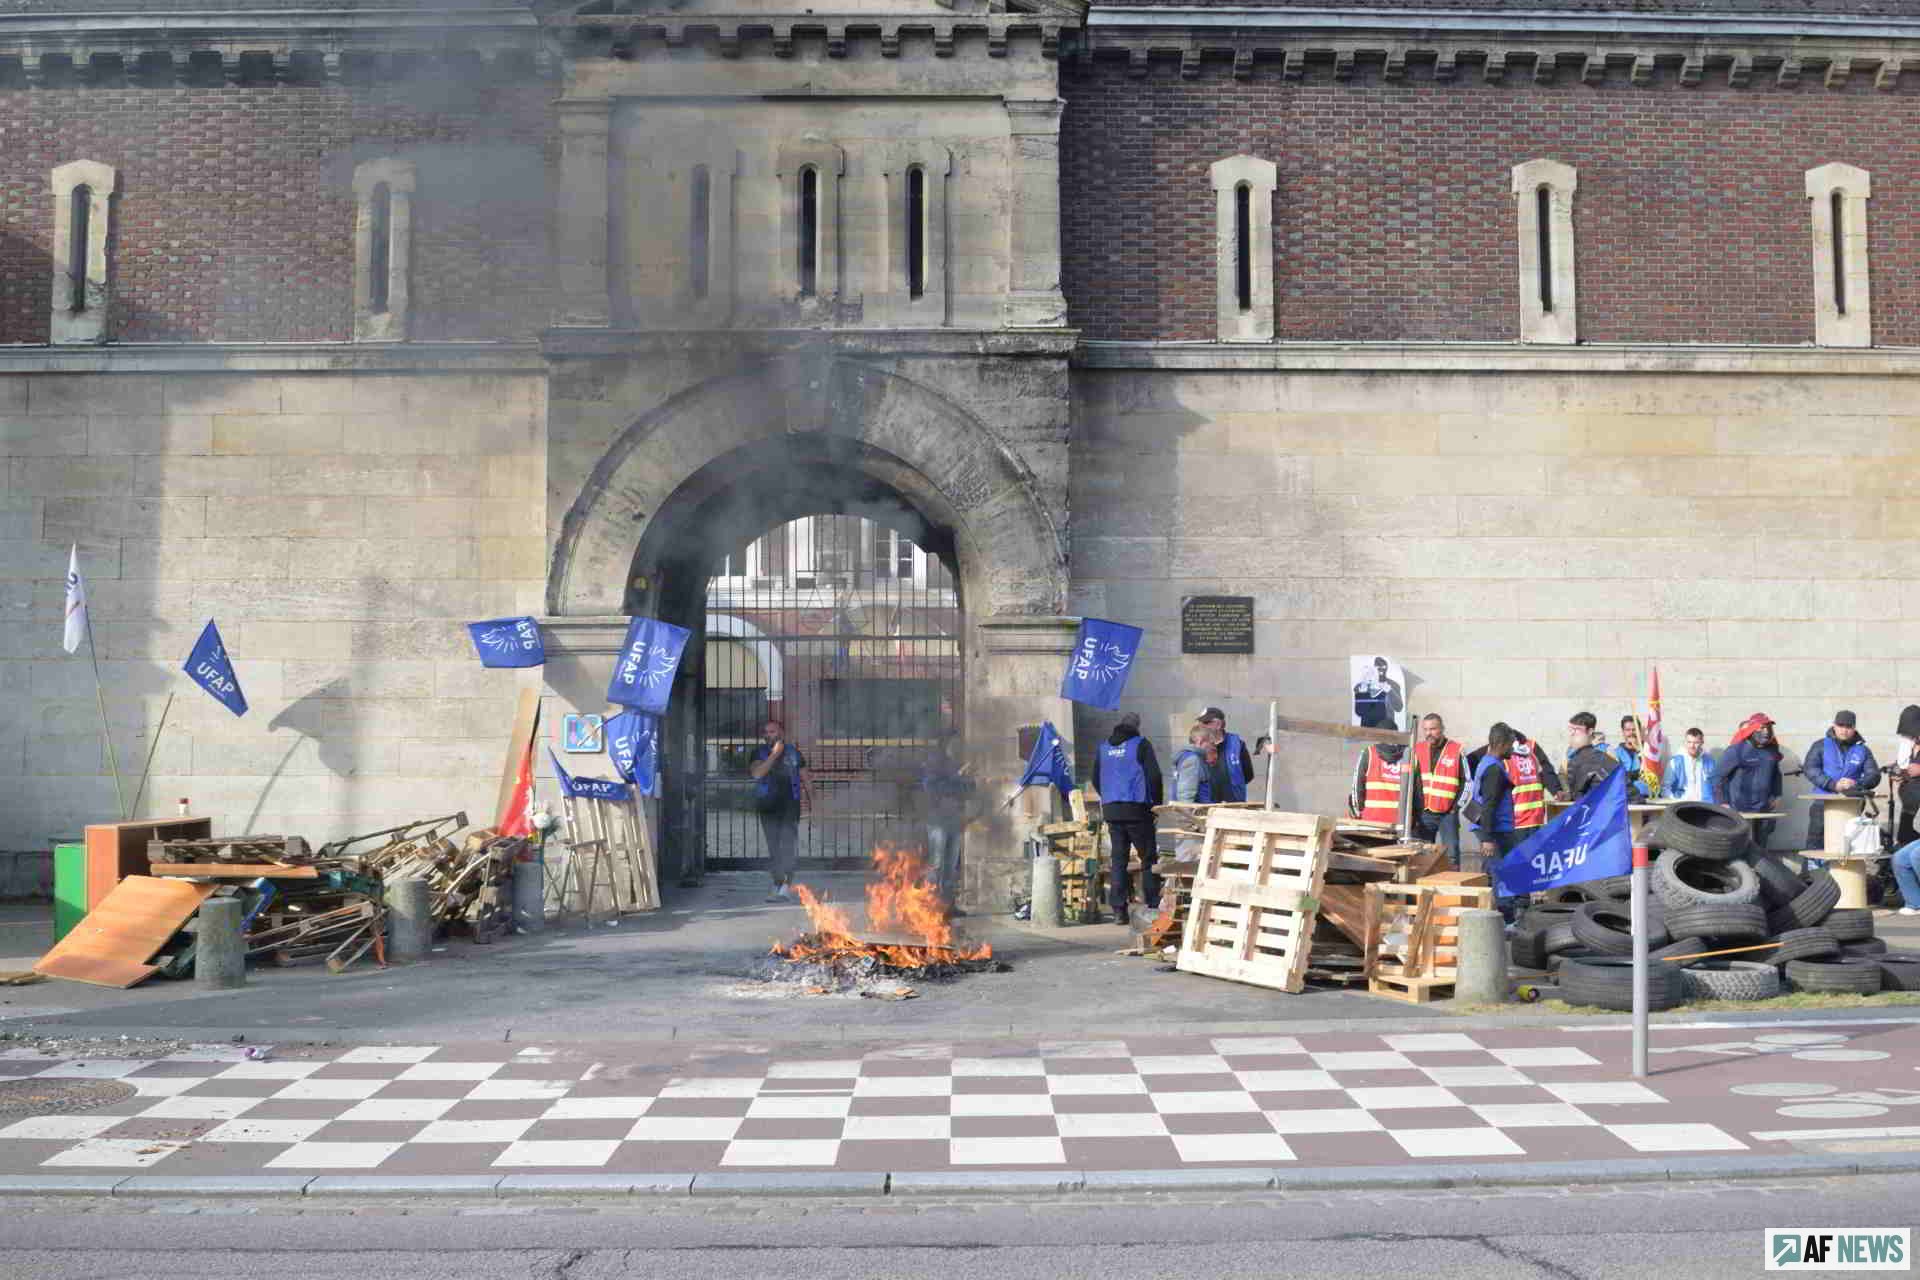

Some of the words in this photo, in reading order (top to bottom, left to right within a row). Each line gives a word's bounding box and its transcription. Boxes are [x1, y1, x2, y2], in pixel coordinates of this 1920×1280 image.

[196, 661, 235, 692] UFAP
[623, 641, 646, 684] UFAP
[1075, 637, 1097, 680] UFAP
[615, 736, 634, 774] UFA
